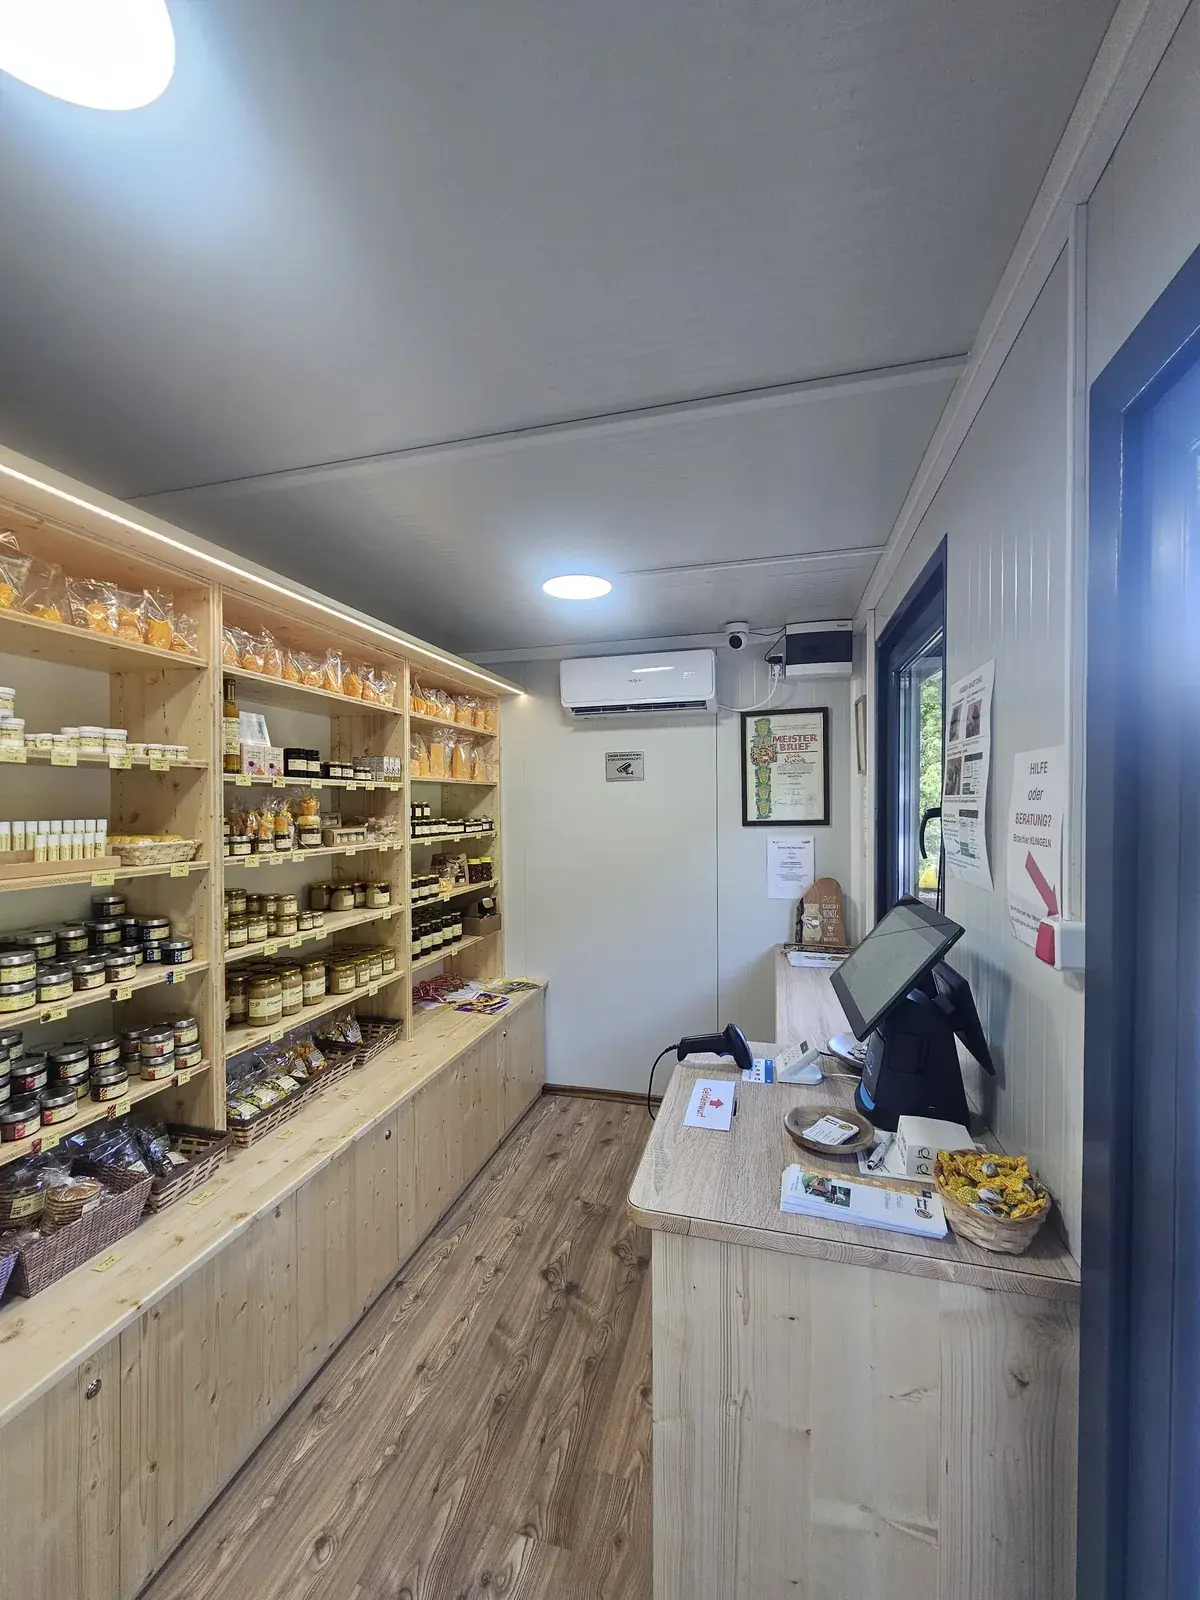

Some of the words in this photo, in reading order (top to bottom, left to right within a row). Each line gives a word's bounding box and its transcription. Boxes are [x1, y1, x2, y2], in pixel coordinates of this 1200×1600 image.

[772, 733, 818, 743] MEISTER
[779, 742, 811, 751] BRIEF
[1029, 761, 1048, 775] HILFE
[1027, 787, 1044, 801] oder
[1015, 812, 1052, 828] BERATUNG?
[1030, 836, 1052, 848] KLINGELN
